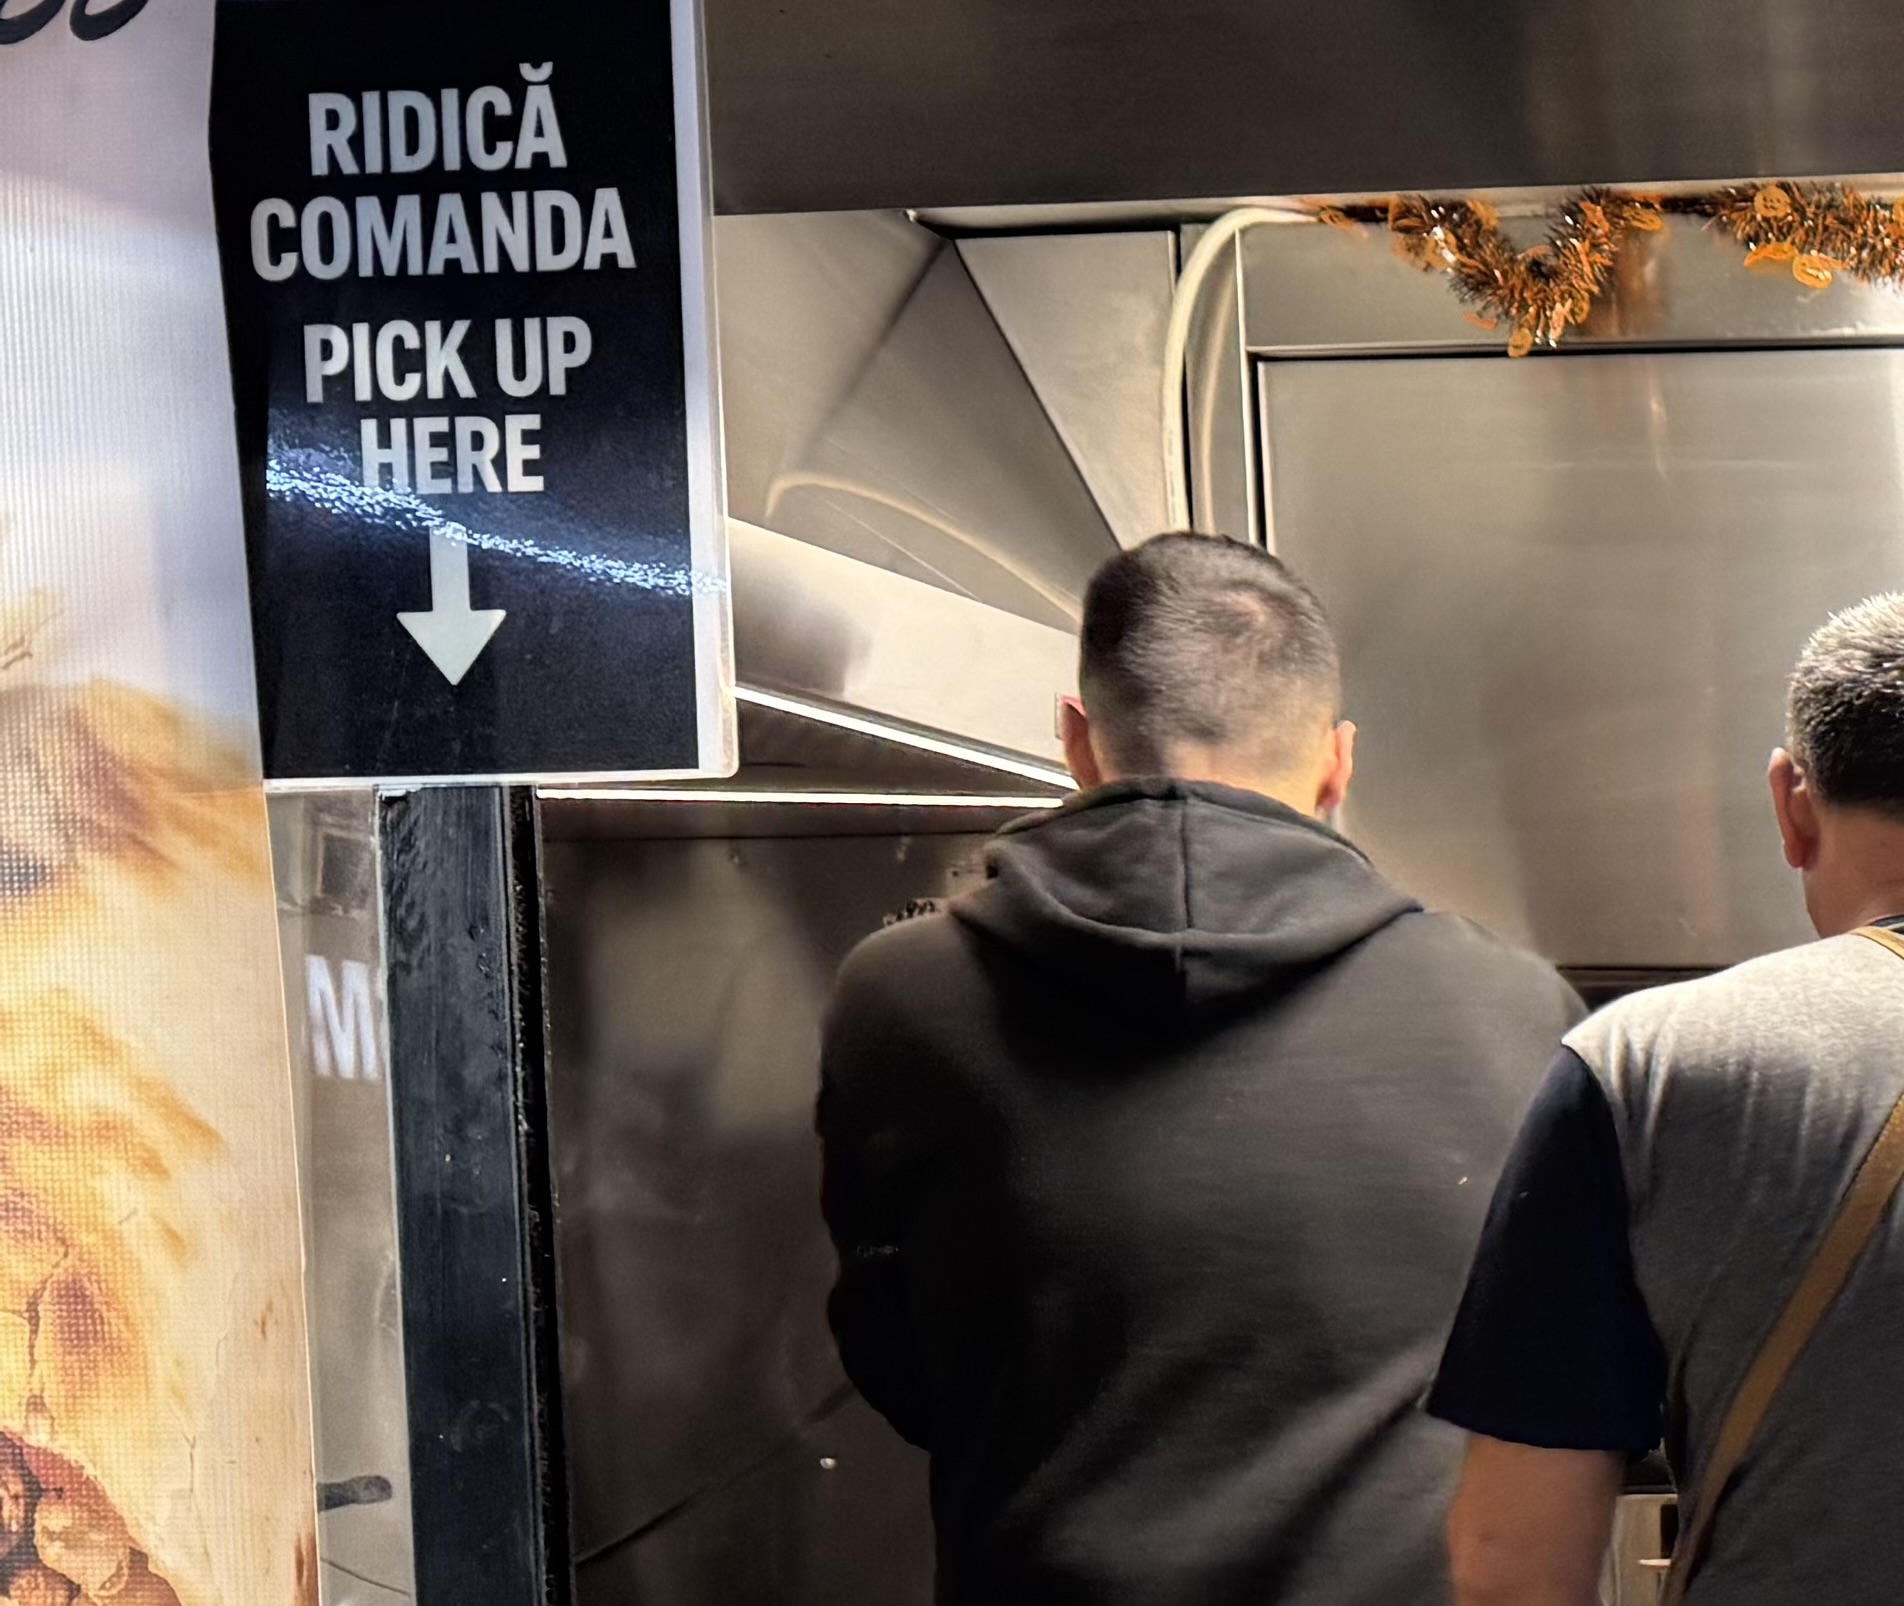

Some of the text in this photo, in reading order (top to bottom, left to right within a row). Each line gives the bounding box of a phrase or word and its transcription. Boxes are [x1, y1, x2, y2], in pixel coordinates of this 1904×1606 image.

[308, 61, 567, 176] RIDICĂ
[250, 187, 636, 281] COMANDA
[303, 316, 592, 403] PICK UP
[360, 414, 545, 494] HERE
